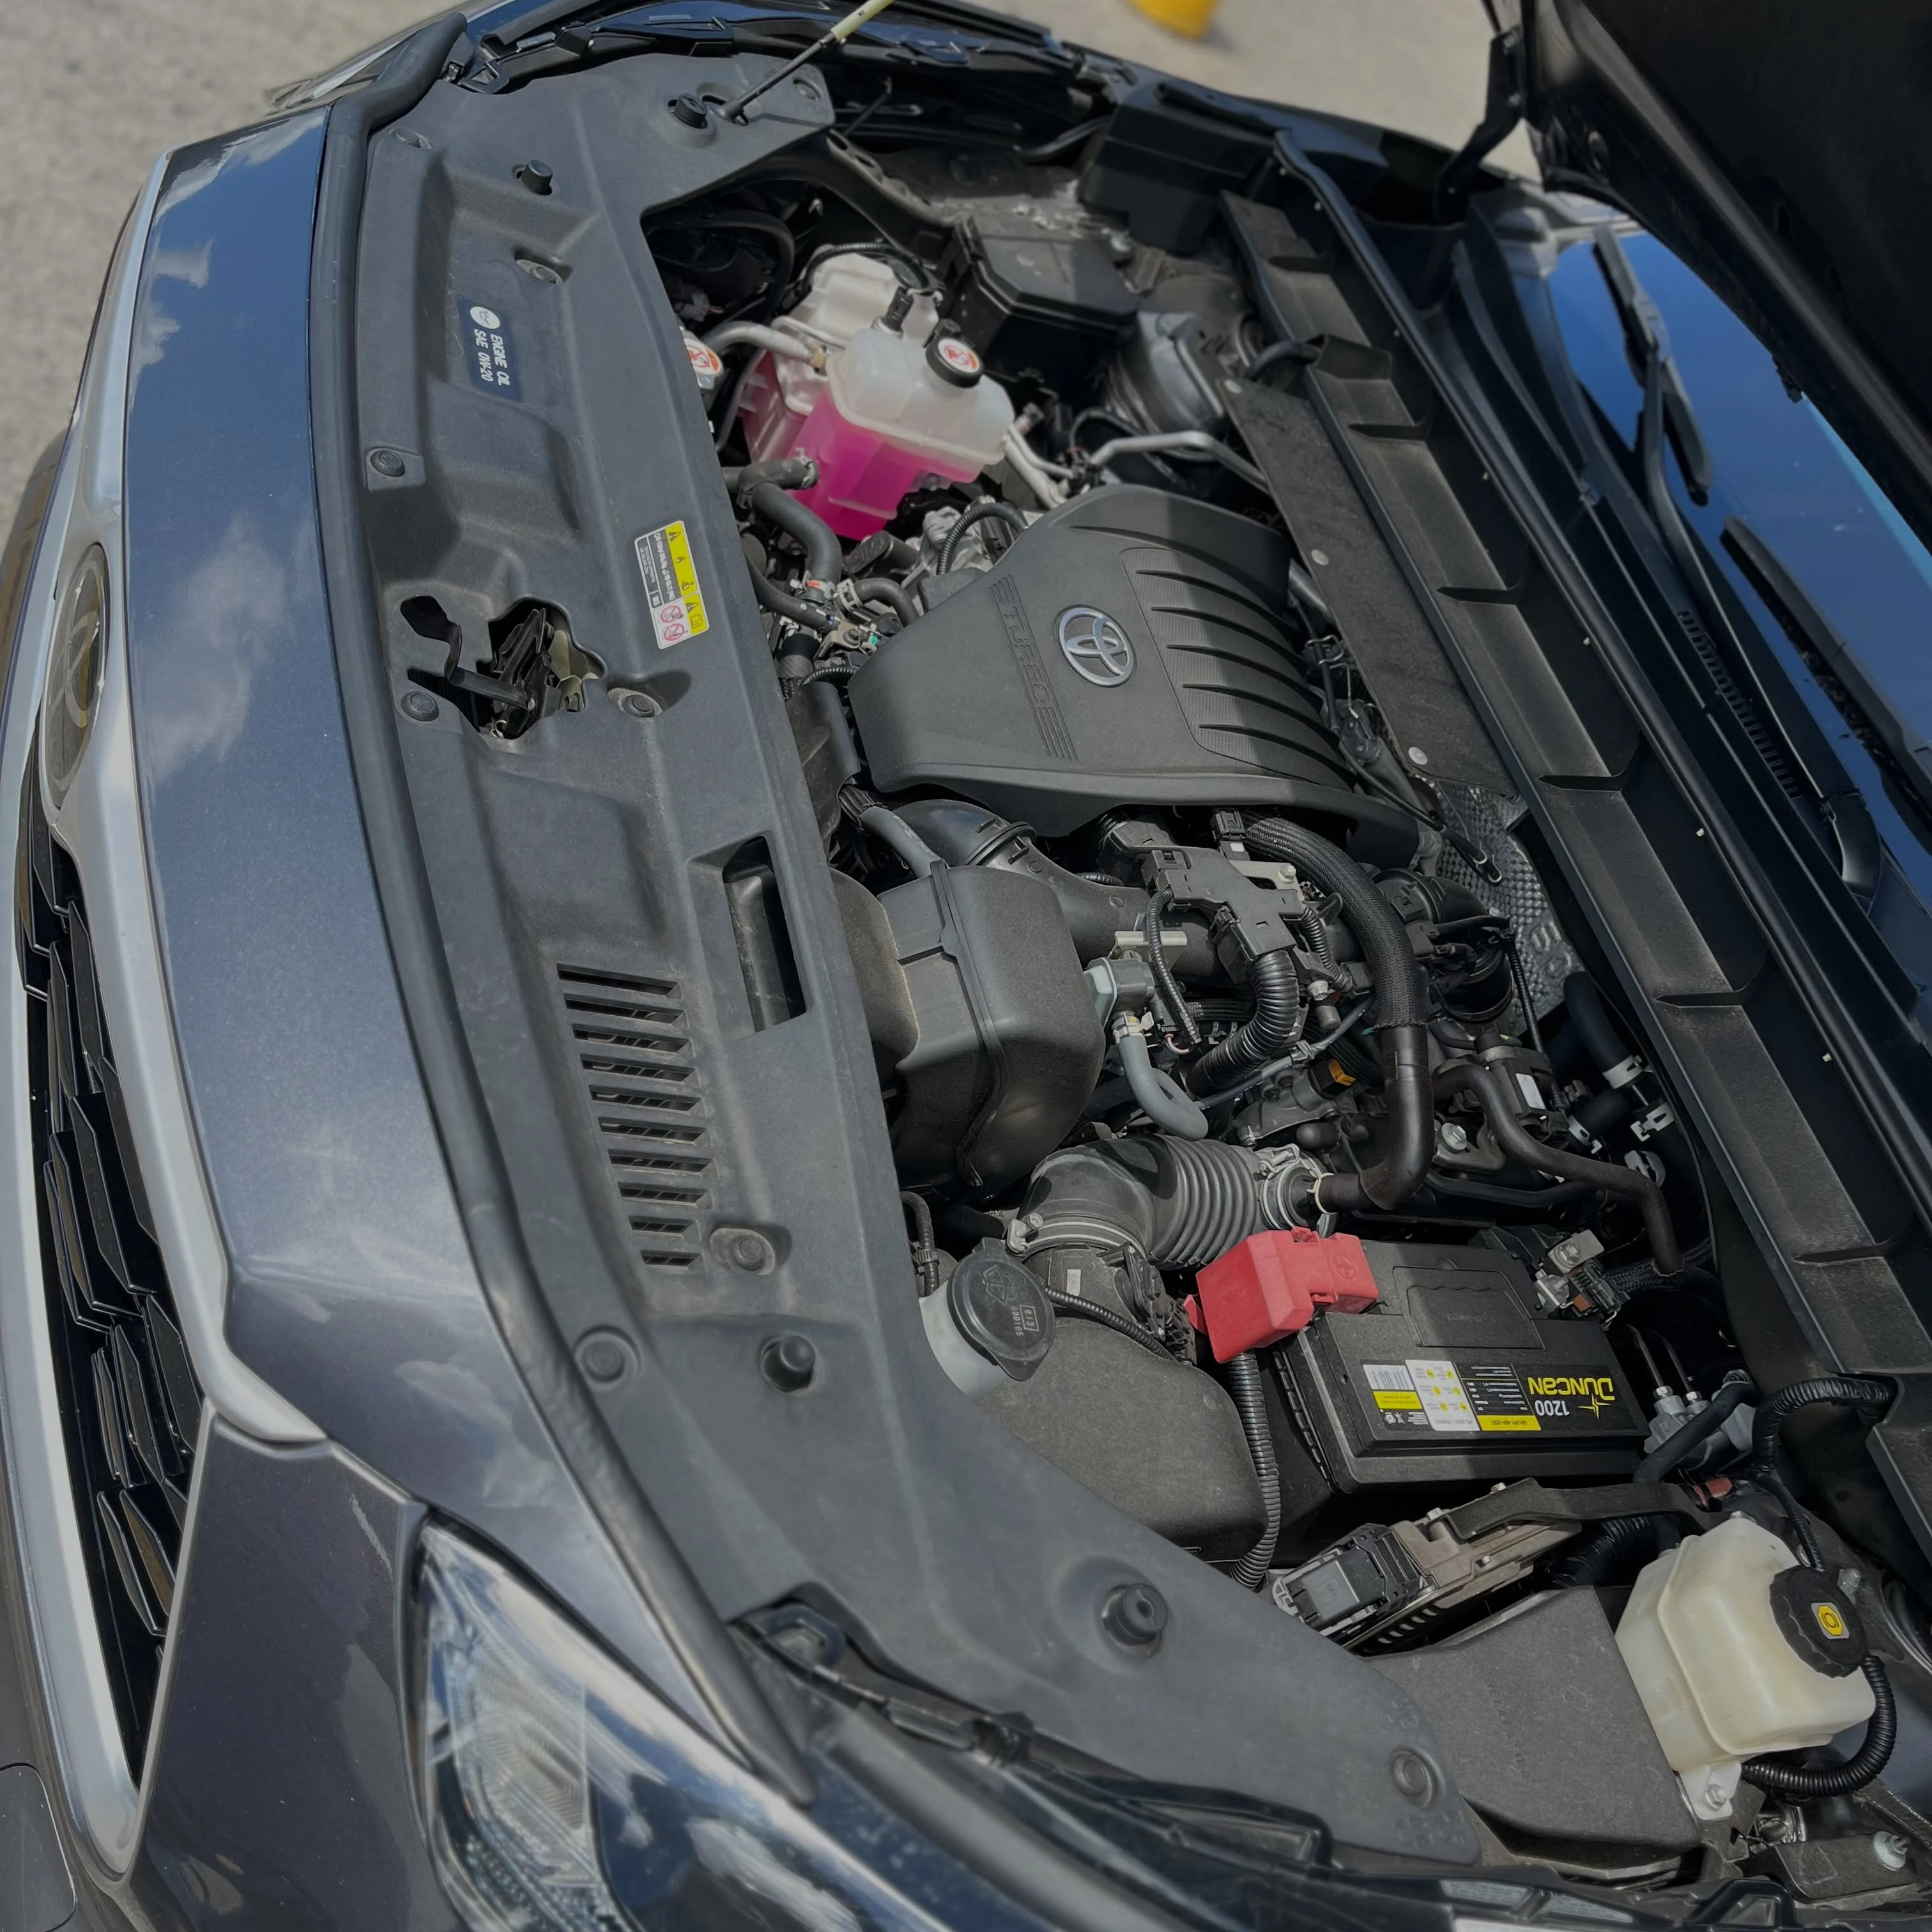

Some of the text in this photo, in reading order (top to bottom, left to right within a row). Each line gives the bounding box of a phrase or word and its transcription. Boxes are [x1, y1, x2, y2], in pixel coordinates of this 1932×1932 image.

[473, 328, 494, 382] SAE 0W-20
[490, 334, 510, 386] ENGINE OIL
[1002, 605, 1051, 705] TURBO
[1011, 1306, 1023, 1337] 000105
[1535, 1400, 1570, 1416] 1200
